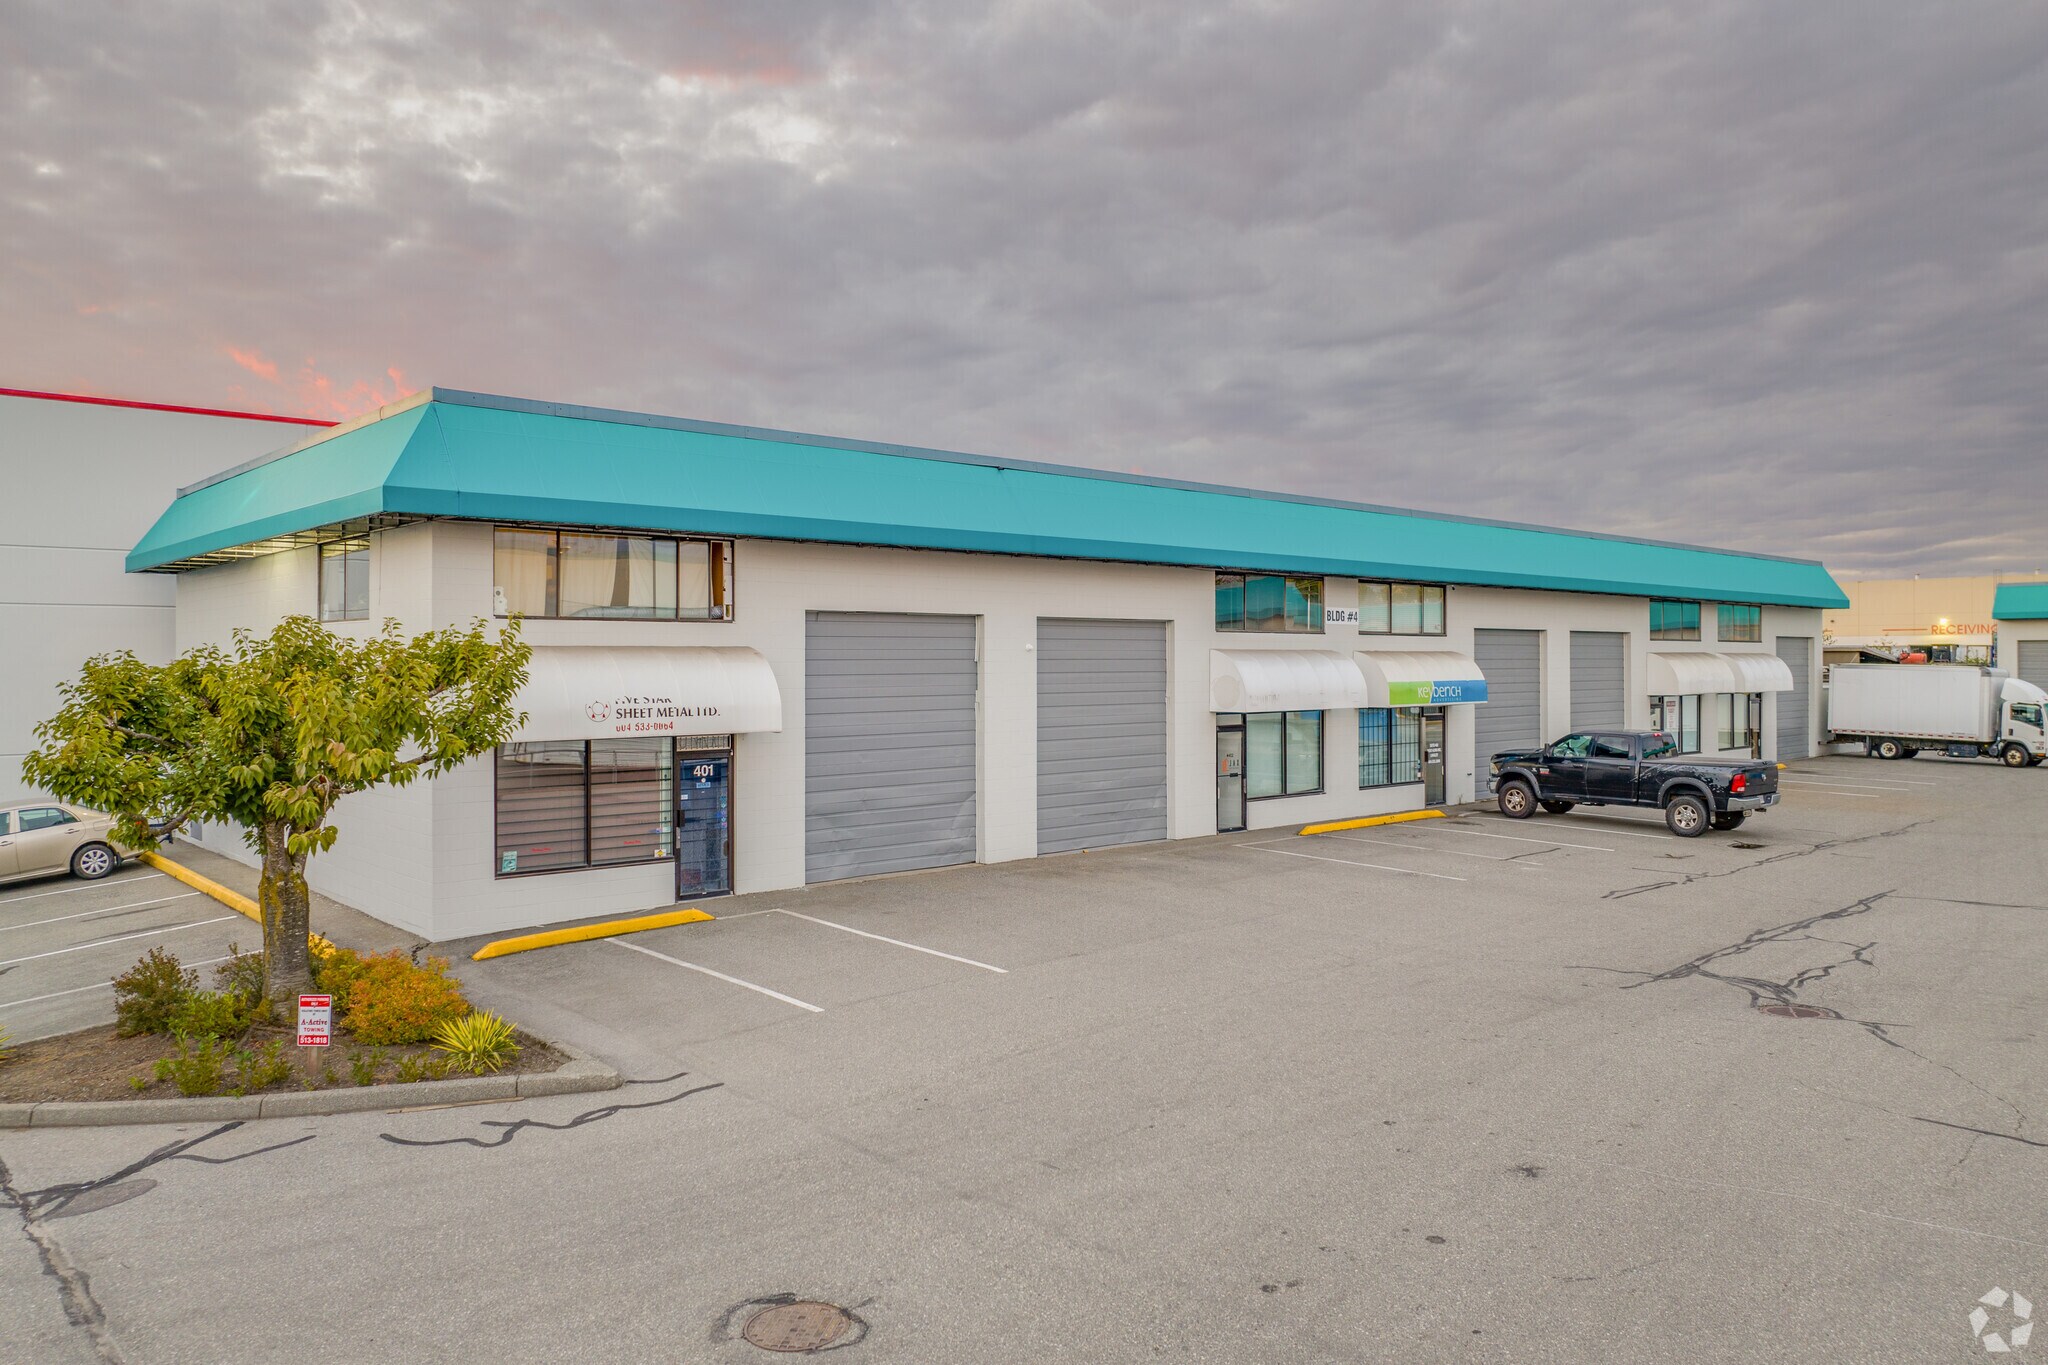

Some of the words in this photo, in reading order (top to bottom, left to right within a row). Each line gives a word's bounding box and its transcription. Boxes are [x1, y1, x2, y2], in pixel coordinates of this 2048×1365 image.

[1326, 610, 1345, 622] BLDG
[1347, 611, 1358, 622] #4
[615, 707, 653, 720] SHEET
[656, 706, 694, 718] METAL
[693, 764, 714, 777] 401
